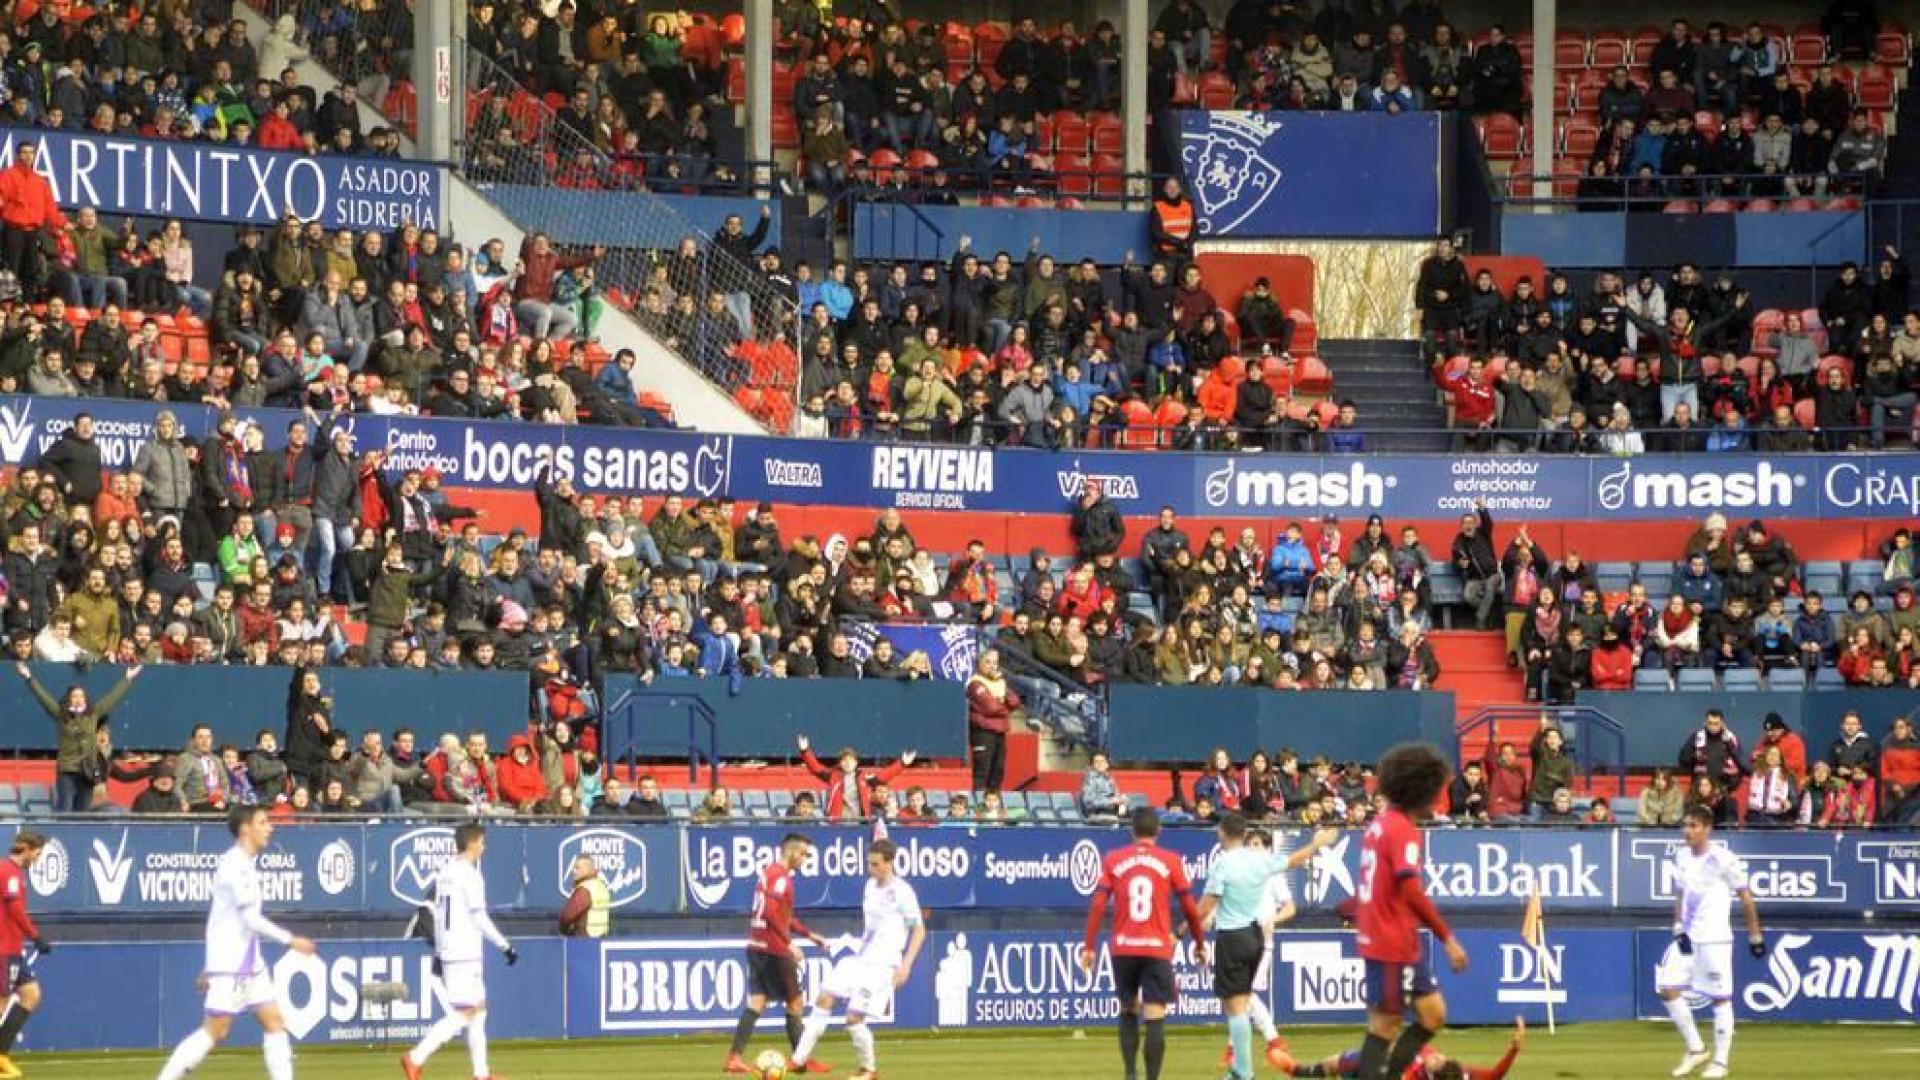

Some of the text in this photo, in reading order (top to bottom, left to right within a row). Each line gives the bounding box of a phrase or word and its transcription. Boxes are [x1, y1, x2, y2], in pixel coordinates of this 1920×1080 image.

[338, 165, 430, 197] ASADOR
[336, 198, 436, 230] SIDRERÍA
[464, 427, 689, 492] bocas sanas
[764, 458, 822, 487] VALTRA
[873, 446, 993, 492] REYVENA
[824, 836, 864, 878] del
[893, 837, 969, 878] oloso
[985, 851, 1069, 885] Sagamóvil
[1424, 842, 1603, 897] xaBank
[1128, 875, 1151, 922] 8
[977, 942, 1116, 995] ACUNSA
[1500, 944, 1566, 984] DN
[975, 998, 1120, 1022] SEGUROS DE SALUD
